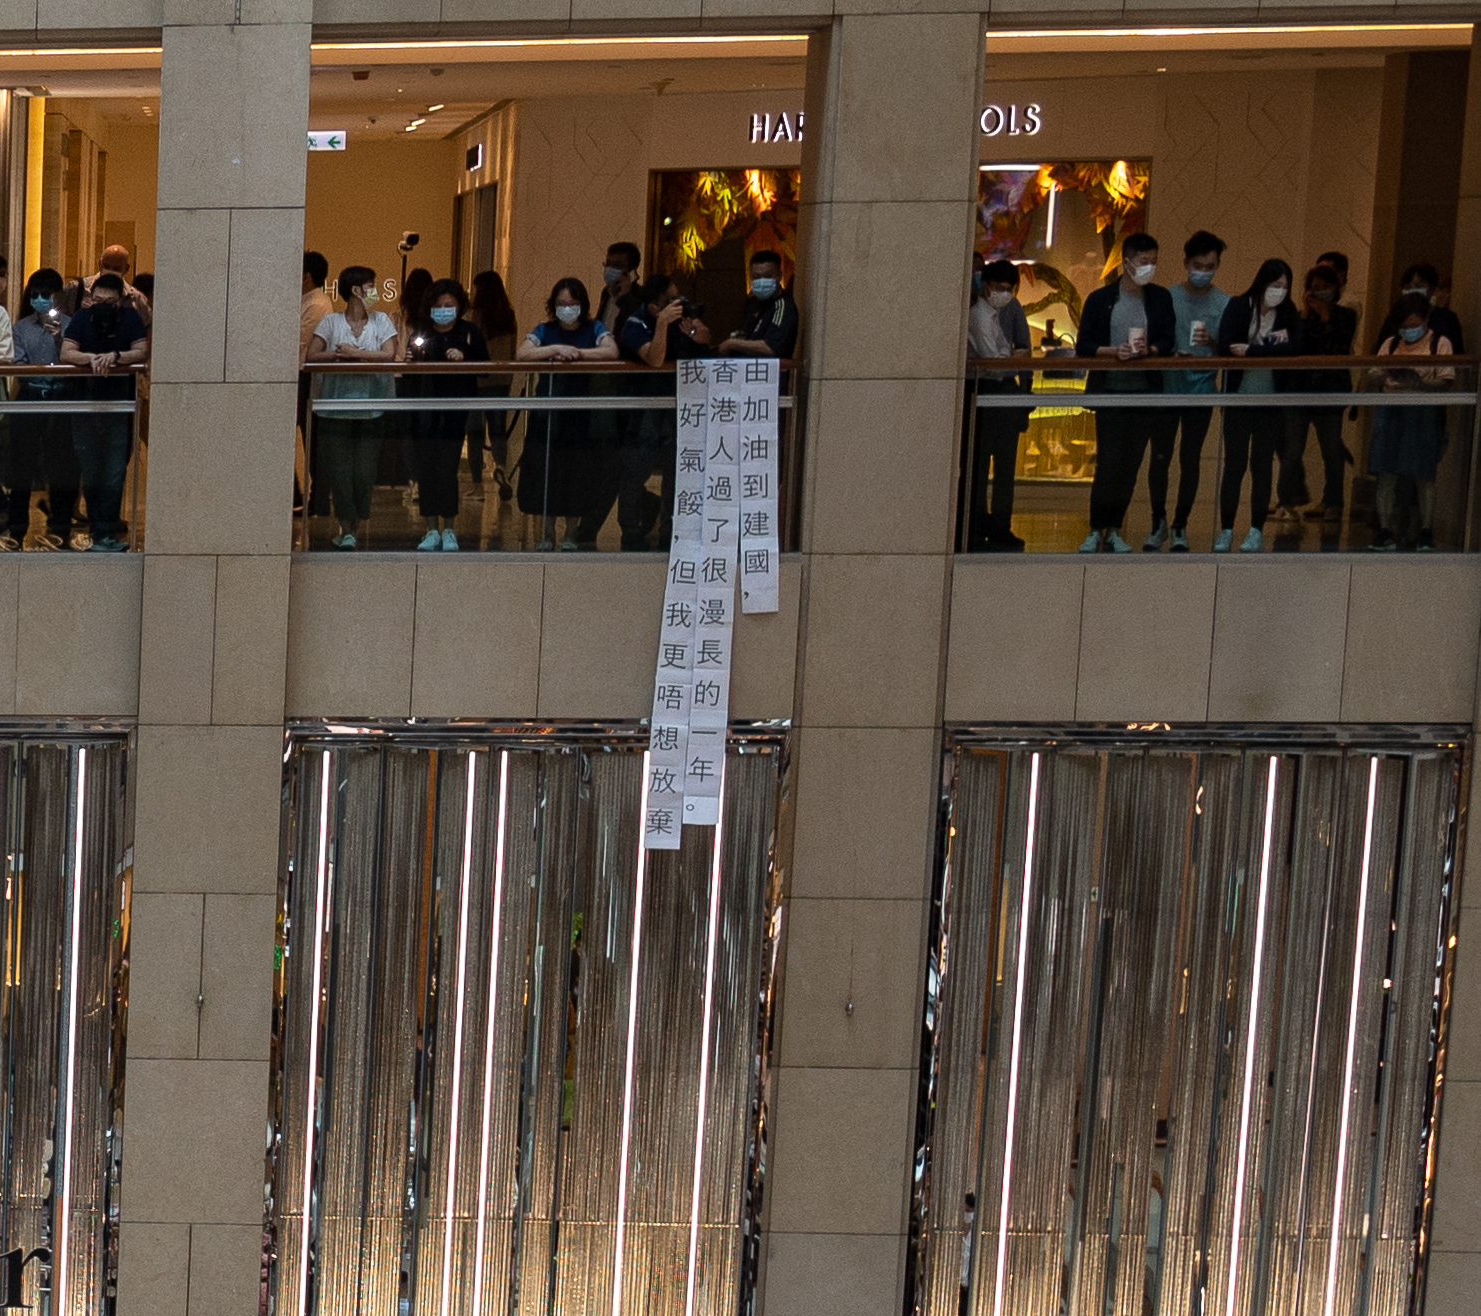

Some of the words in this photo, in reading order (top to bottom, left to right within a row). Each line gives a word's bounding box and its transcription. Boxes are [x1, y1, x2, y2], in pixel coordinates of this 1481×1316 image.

[684, 360, 738, 813] 香港人過了很漫長的一年。
